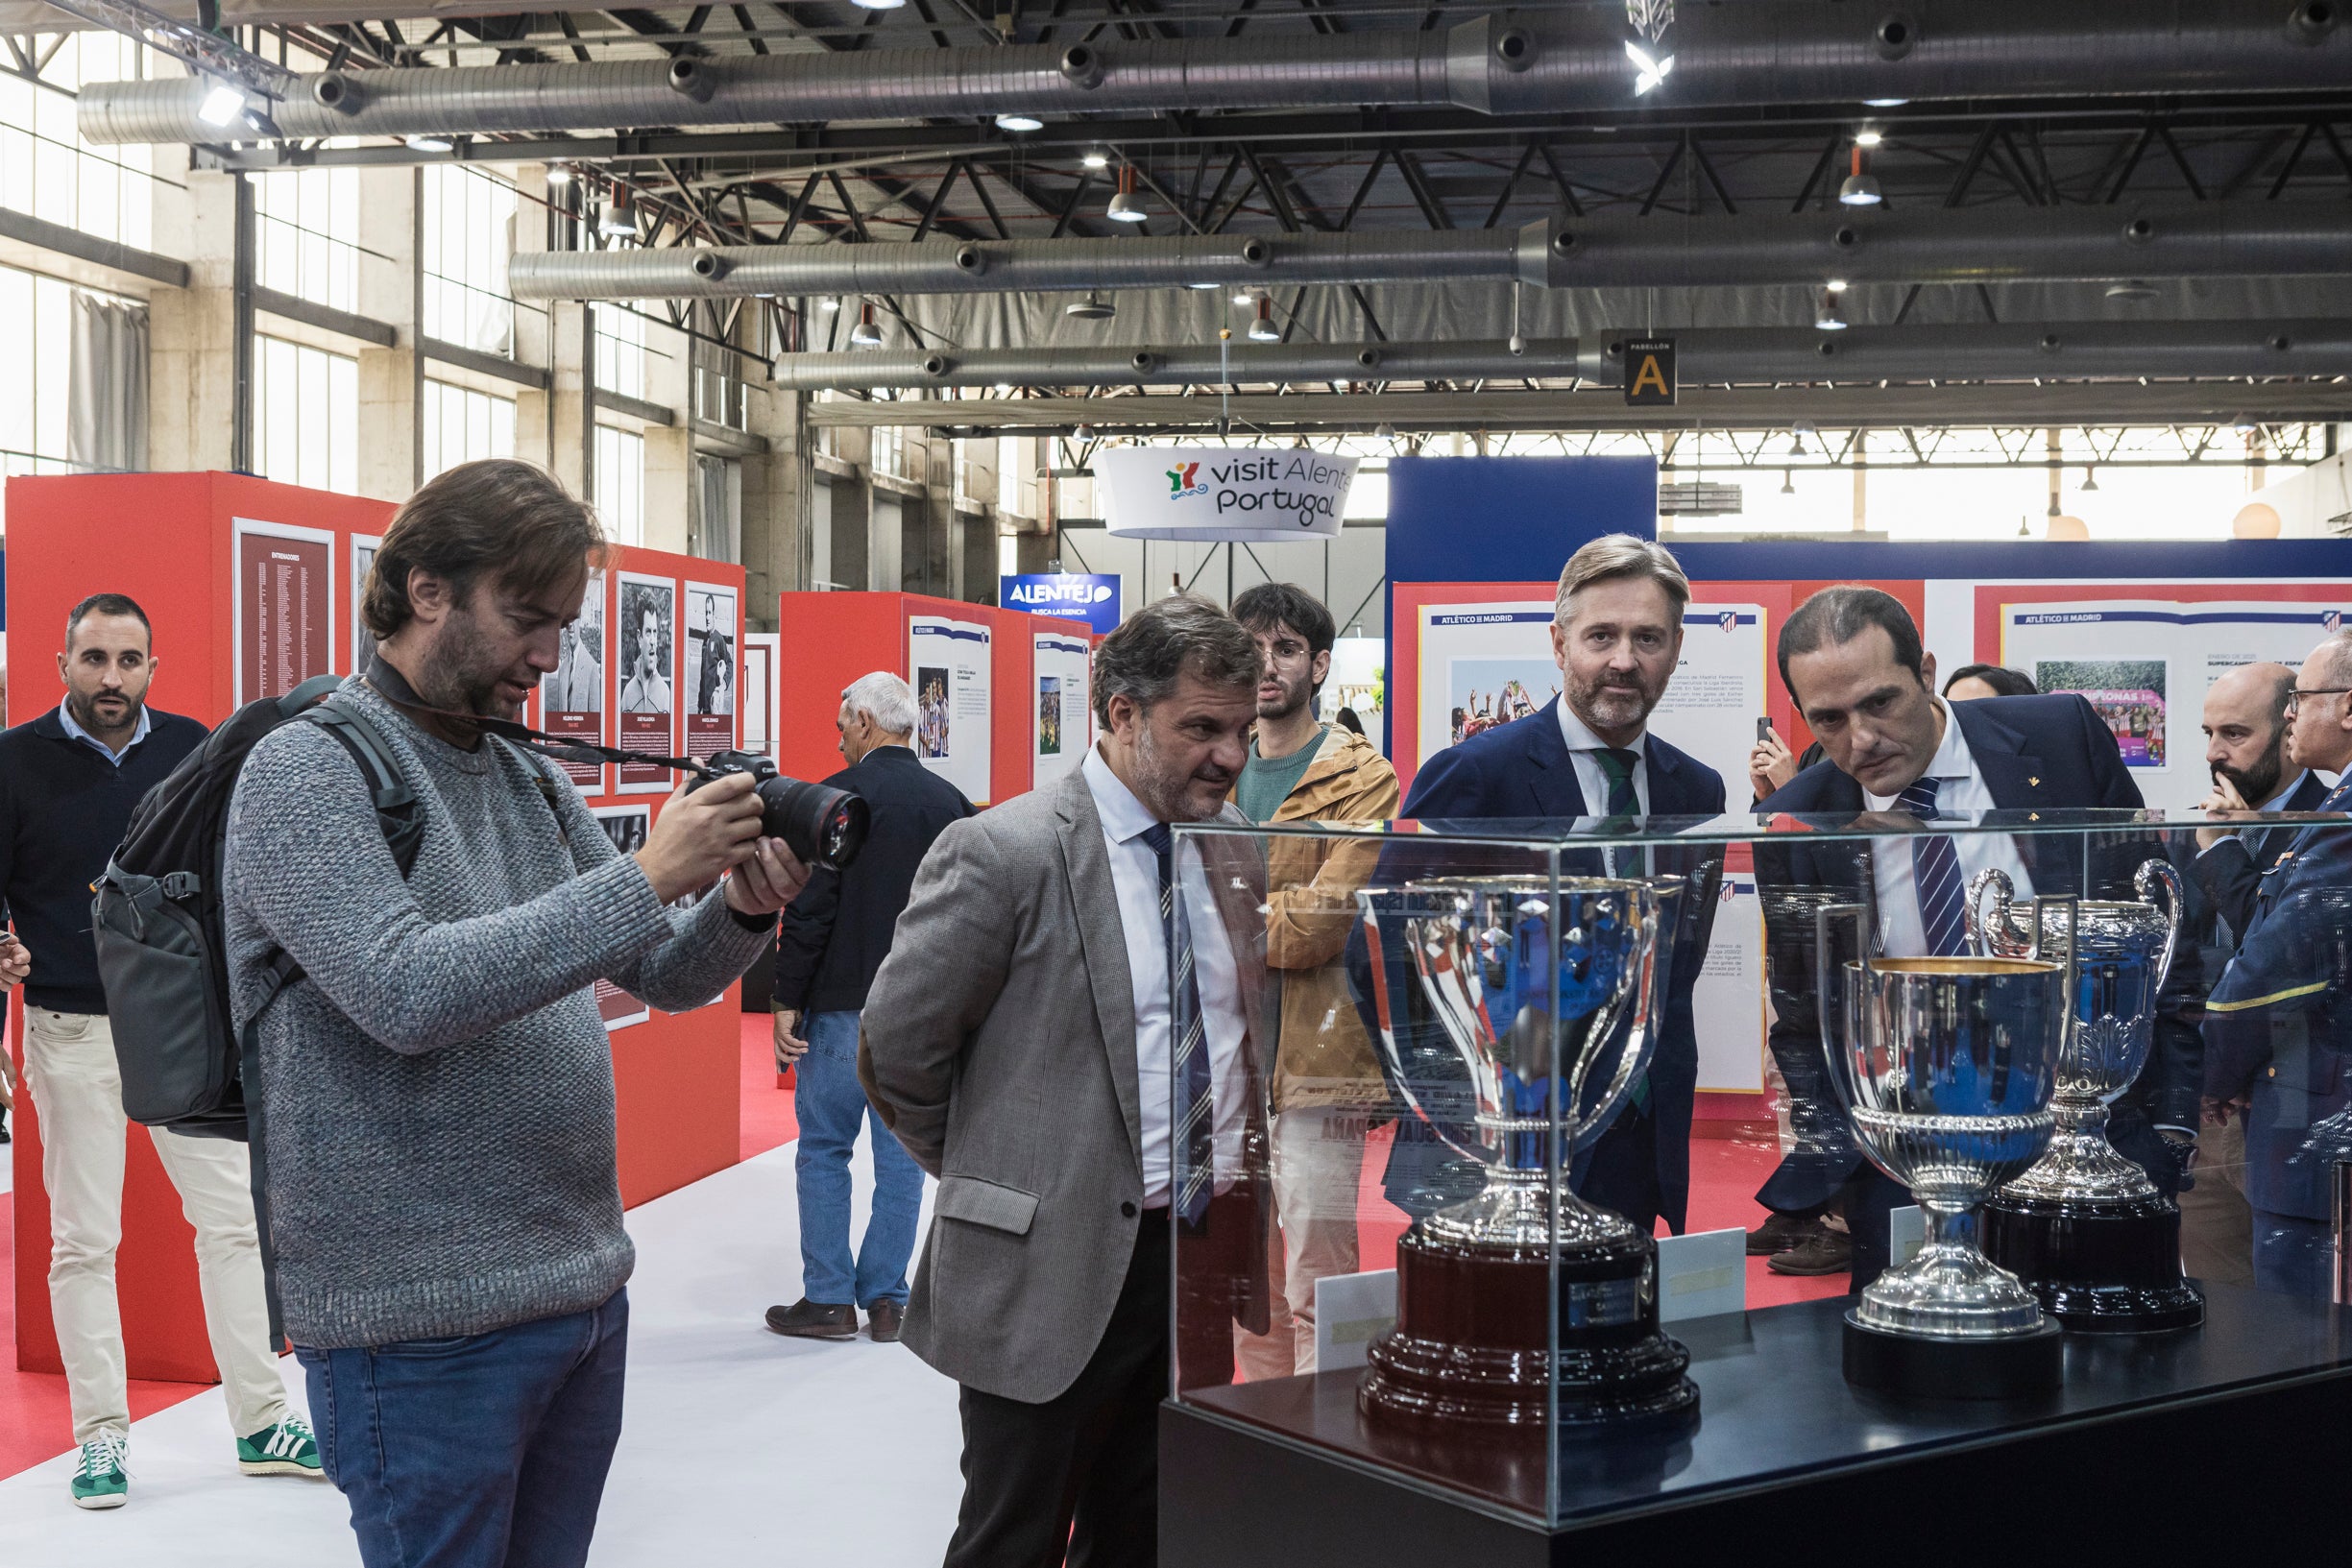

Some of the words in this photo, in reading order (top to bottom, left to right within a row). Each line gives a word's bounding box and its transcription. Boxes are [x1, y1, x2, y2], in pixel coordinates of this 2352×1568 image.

[1632, 355, 1668, 396] A
[1211, 457, 1279, 484] visit
[272, 552, 300, 561] ENTRENADORES
[1442, 615, 1476, 624] ATLÉTICO
[2025, 615, 2062, 623] ATLÉTICO
[2070, 614, 2101, 622] MADRID
